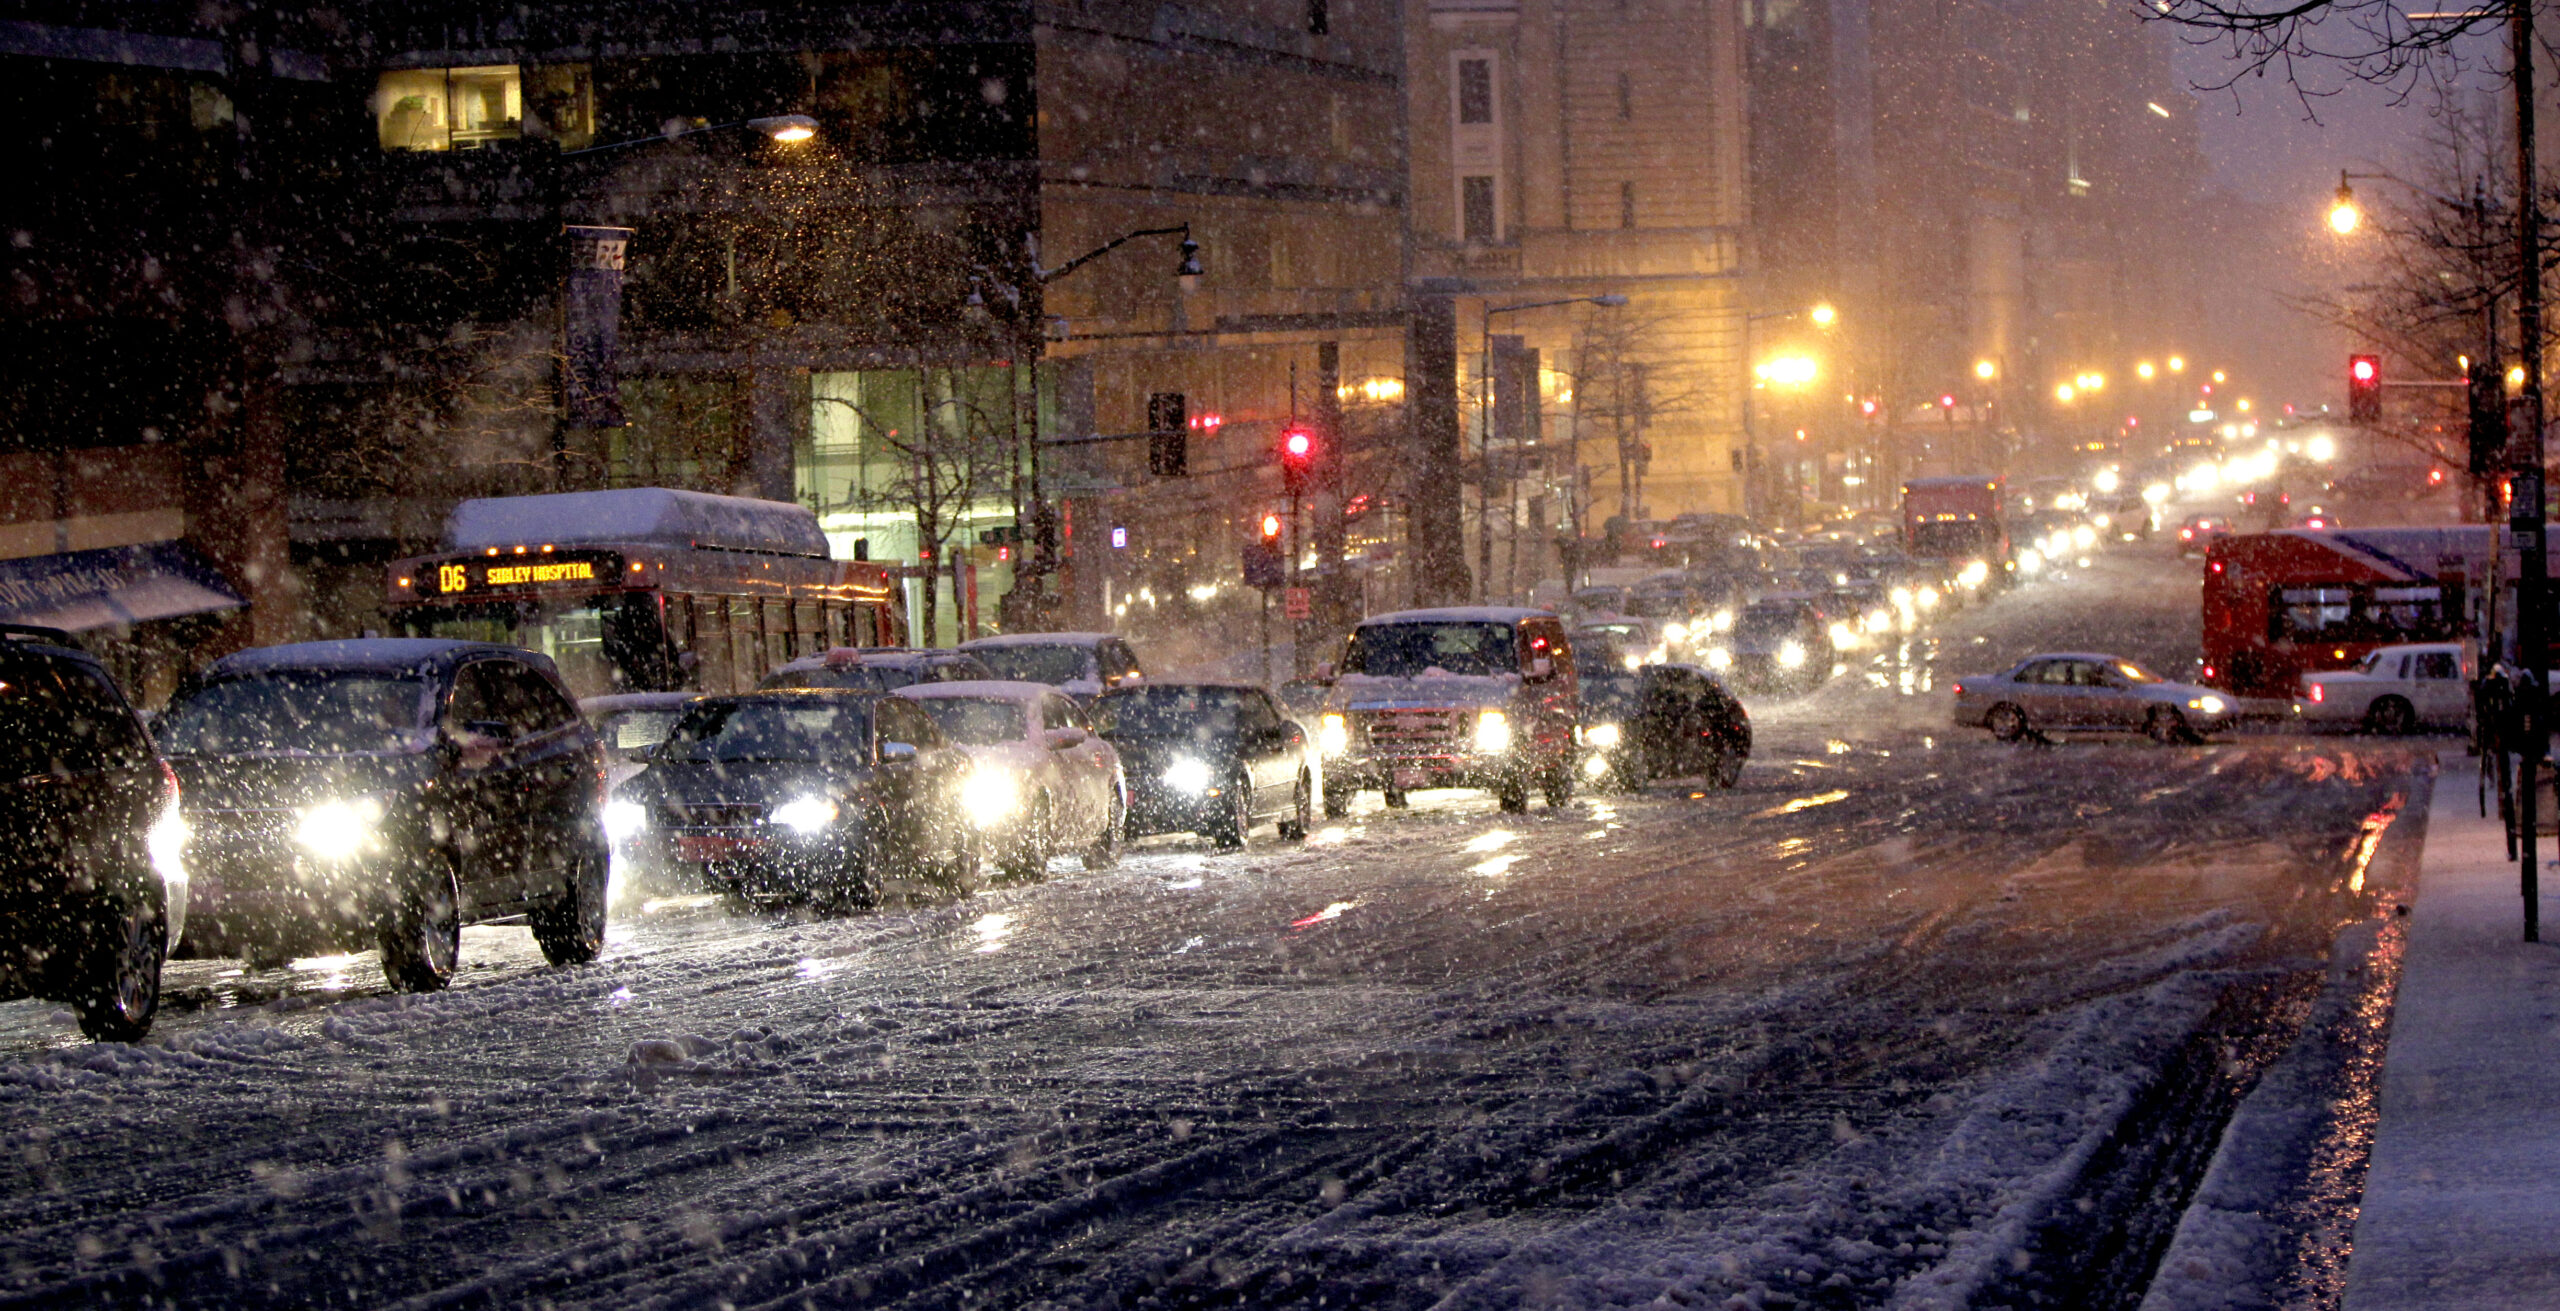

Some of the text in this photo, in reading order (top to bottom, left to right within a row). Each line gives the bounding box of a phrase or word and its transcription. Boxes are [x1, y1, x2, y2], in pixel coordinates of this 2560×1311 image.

[440, 562, 595, 591] D6 SIBLEY HOSPITAL
